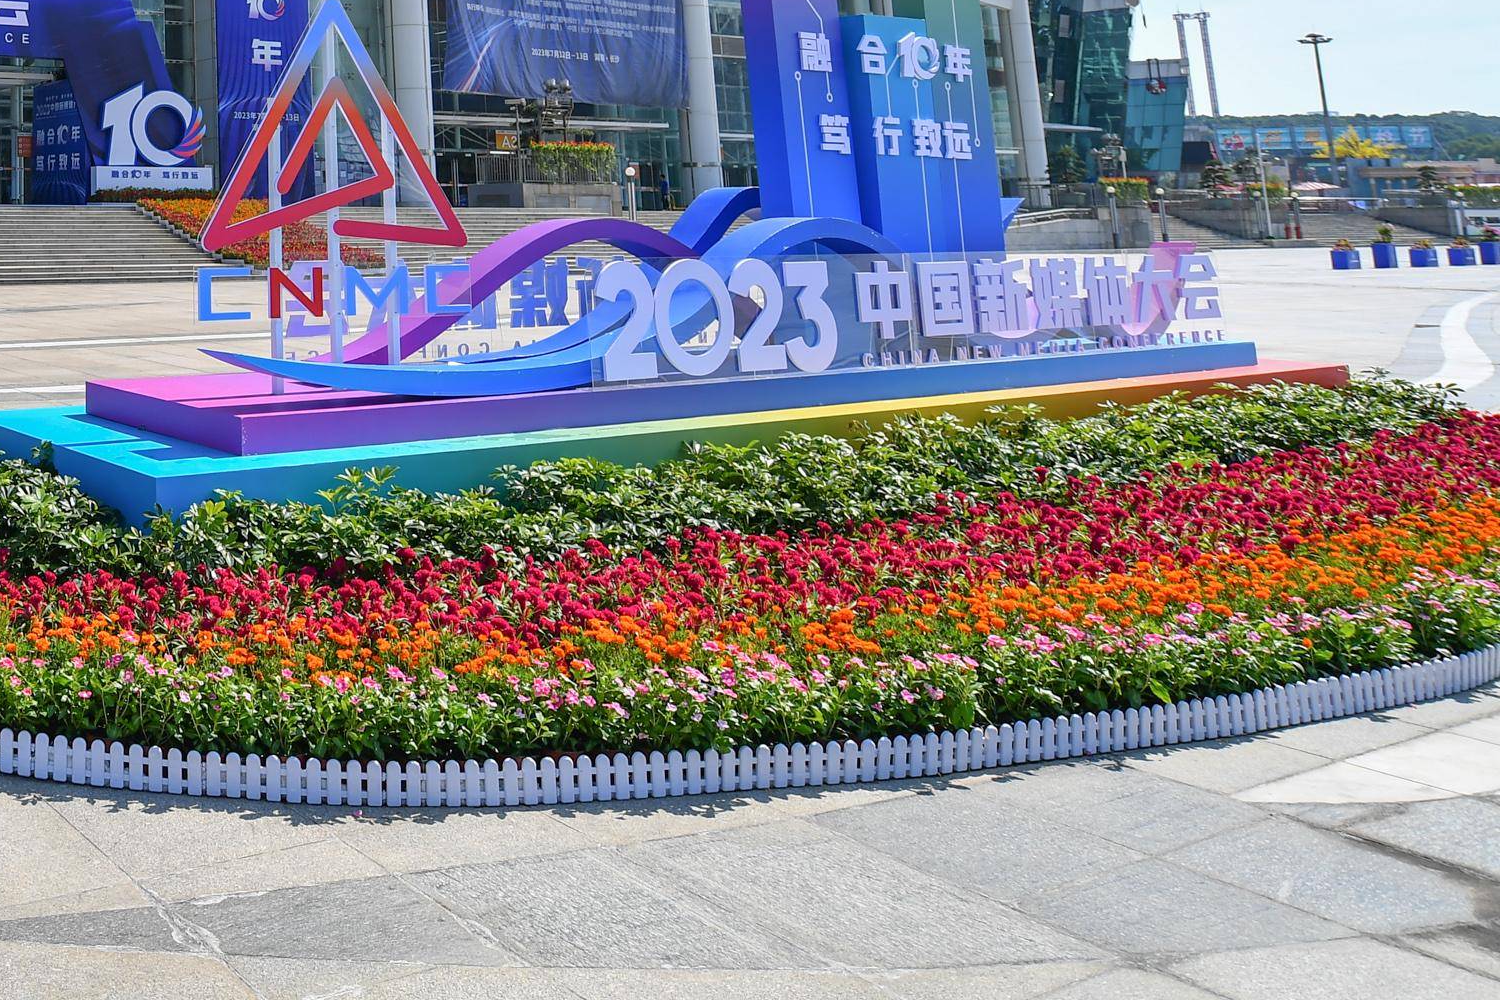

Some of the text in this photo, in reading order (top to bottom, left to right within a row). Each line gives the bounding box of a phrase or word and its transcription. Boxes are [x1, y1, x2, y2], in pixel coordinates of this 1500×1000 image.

[797, 31, 973, 83] 融合10年
[819, 113, 973, 160] 笃行致远
[197, 263, 473, 322] CNMC
[595, 256, 838, 381] 2023
[854, 253, 1223, 340] 中国新媒体大会
[861, 328, 1225, 368] CHINA NEW MEDIA CONFERENCE
